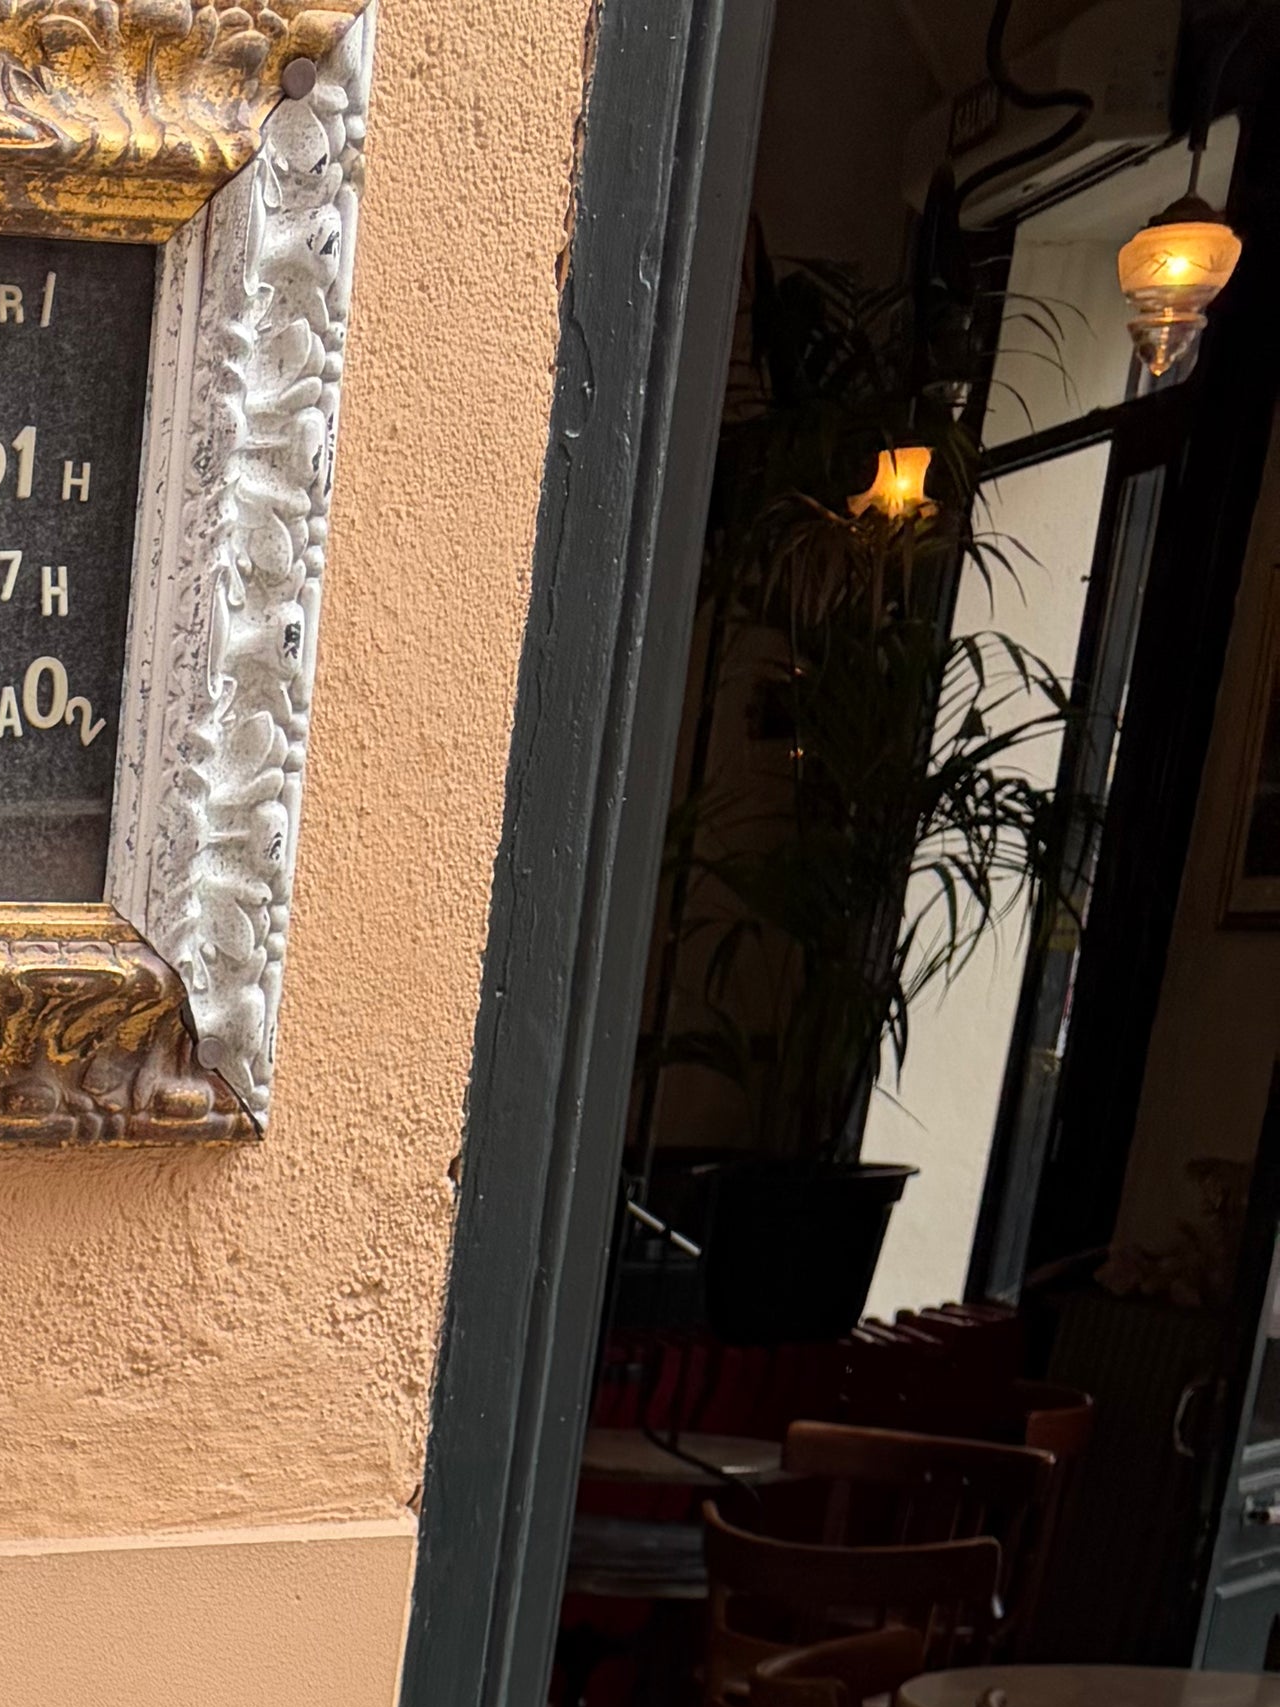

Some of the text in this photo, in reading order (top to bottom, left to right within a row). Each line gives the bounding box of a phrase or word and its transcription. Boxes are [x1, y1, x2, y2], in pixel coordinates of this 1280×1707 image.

[61, 460, 91, 502] H
[40, 565, 69, 616] H
[23, 656, 107, 747] 02
